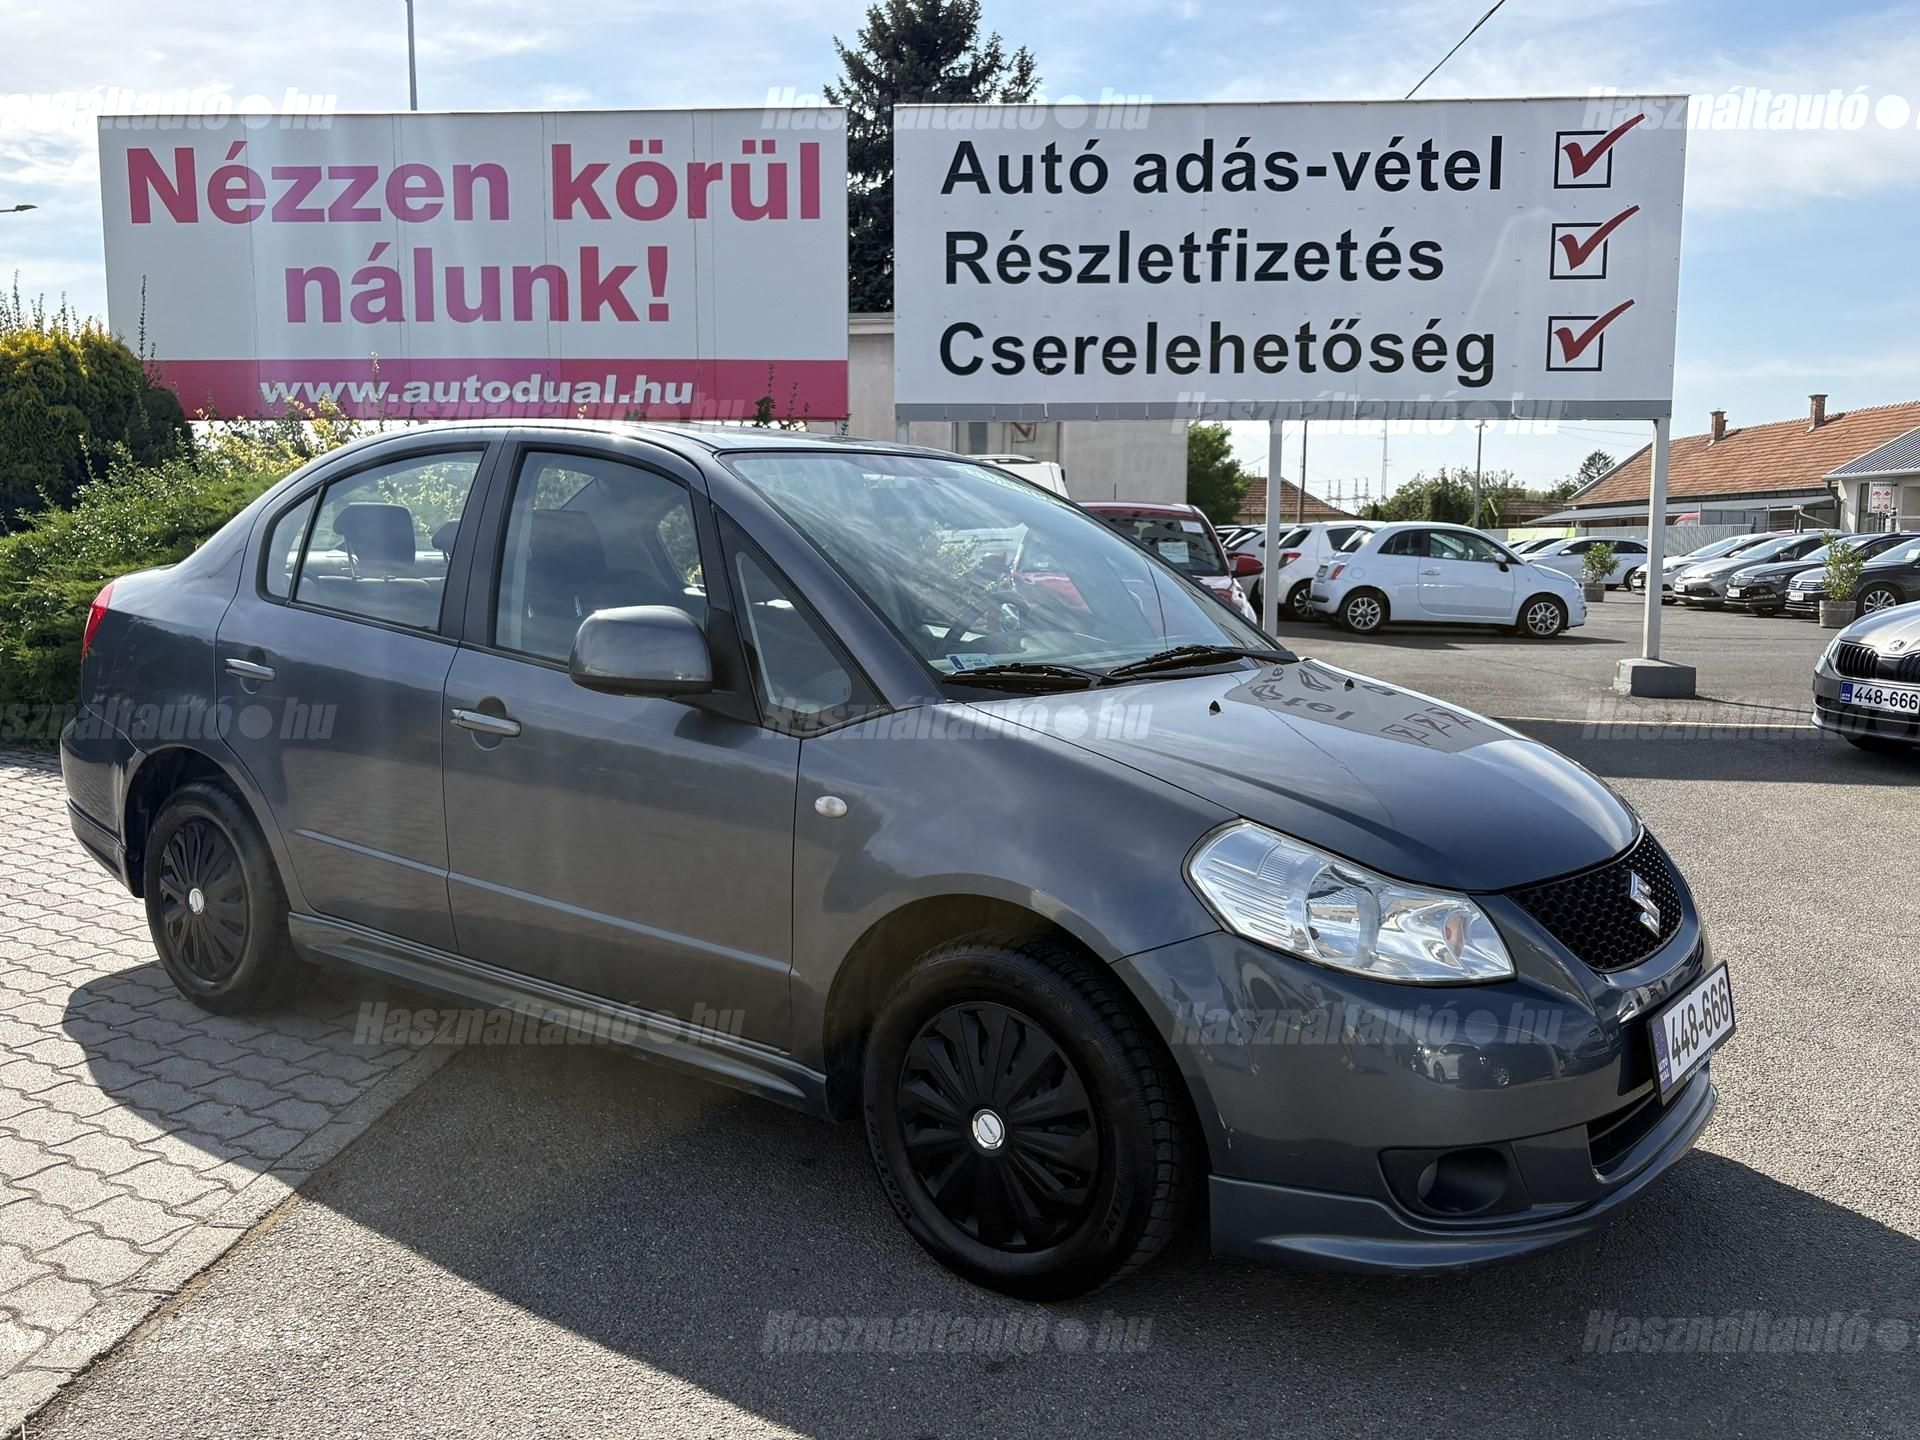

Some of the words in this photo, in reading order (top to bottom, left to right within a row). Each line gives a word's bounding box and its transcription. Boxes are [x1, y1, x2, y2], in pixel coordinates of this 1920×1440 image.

[127, 142, 508, 224] Nézzen
[552, 140, 821, 220] körül
[939, 138, 1109, 196] Autó
[1132, 134, 1504, 194] adás-vétel
[285, 241, 669, 323] nálunk!
[944, 225, 1445, 285] Részletfizetés
[938, 317, 1495, 389] Cserelehetőség
[259, 373, 693, 409] www.autodual.hu
[1854, 686, 1919, 710] 448-666
[1670, 976, 1730, 1067] 448-666
